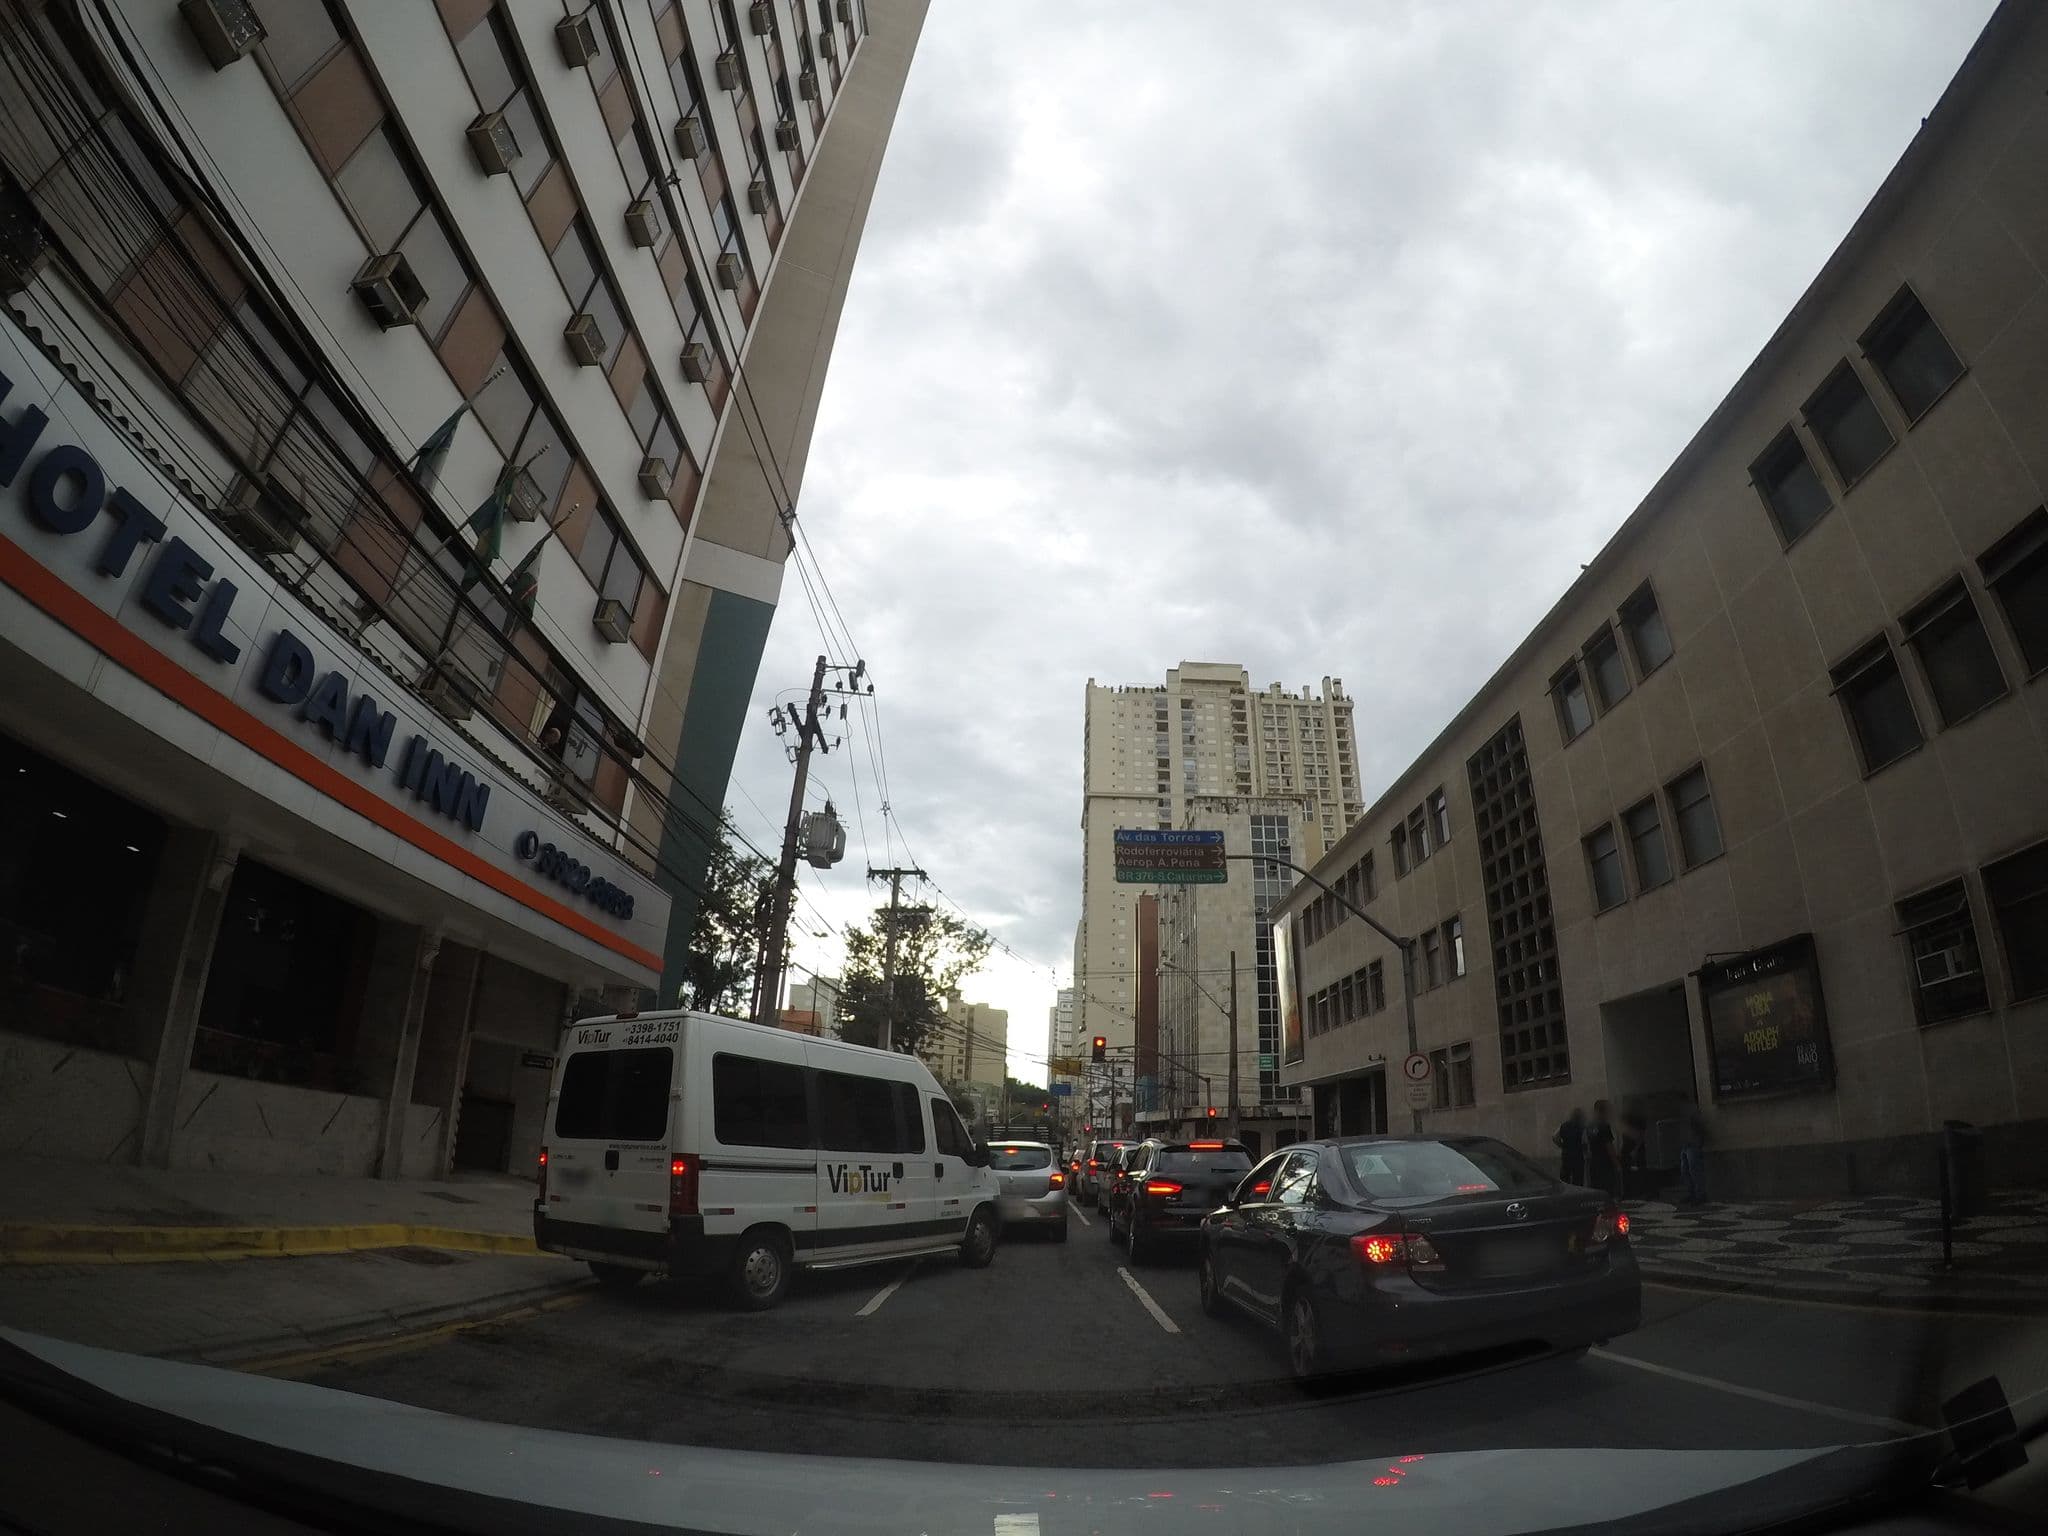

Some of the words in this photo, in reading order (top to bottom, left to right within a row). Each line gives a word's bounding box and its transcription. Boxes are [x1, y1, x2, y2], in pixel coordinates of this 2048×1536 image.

[256, 629, 397, 769] DAN
[400, 735, 490, 833] INN
[1116, 832, 1132, 842] Av.
[1135, 832, 1157, 842] das
[1160, 832, 1202, 843] Torres
[629, 1021, 681, 1035] 3398-1751
[627, 1032, 679, 1046] 8414-4040
[826, 1164, 891, 1195] VipTur
